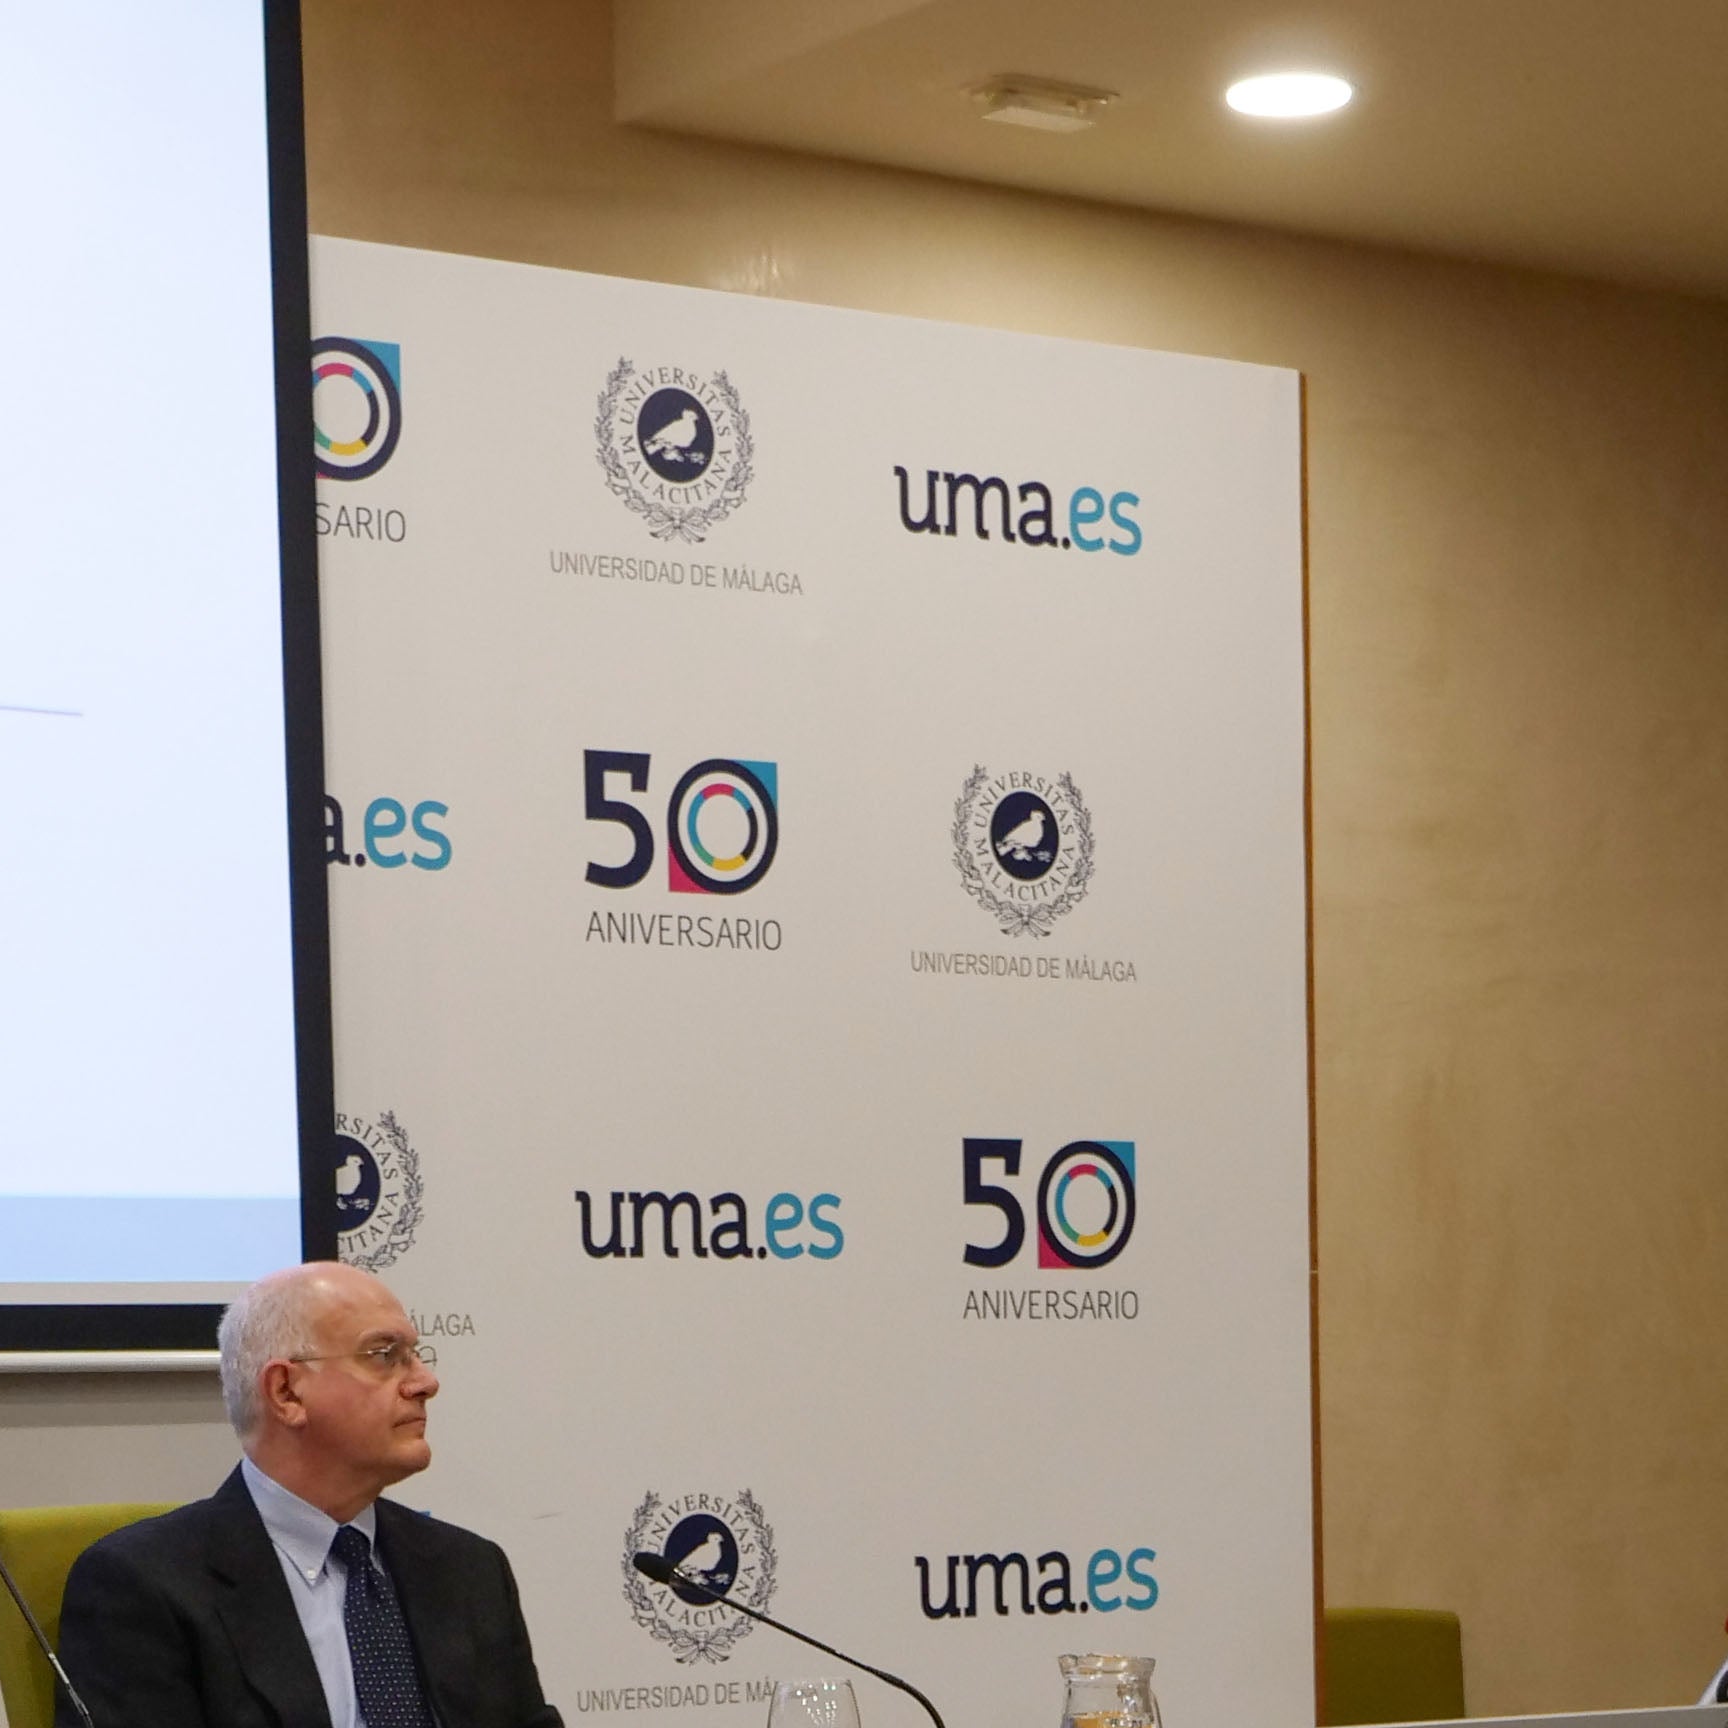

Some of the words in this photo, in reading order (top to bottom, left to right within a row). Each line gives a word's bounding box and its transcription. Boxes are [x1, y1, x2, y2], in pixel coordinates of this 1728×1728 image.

[619, 366, 732, 438] UNIVERSITAS
[621, 433, 731, 505] MALACITANA
[892, 464, 1143, 557] uma.es
[549, 549, 685, 585] UNIVERSIDAD
[690, 563, 717, 587] DE
[723, 564, 804, 596] MÁLAGA
[584, 749, 778, 895] 50
[975, 771, 1073, 836] UNIVERSITAS
[975, 837, 1074, 901] MALACITANA
[586, 911, 782, 950] ANIVERSARIO
[910, 951, 1032, 978] UNIVERSIDAD
[1036, 957, 1060, 979] DE
[1066, 955, 1137, 982] MÁLAGA
[575, 1190, 844, 1260] uma.es
[963, 1138, 1135, 1269] 50
[963, 1290, 1138, 1320] ANIVERSARIO
[915, 1547, 1158, 1619] uma.es
[577, 1683, 709, 1712] UNIVERSIDAD
[714, 1683, 739, 1704] DE
